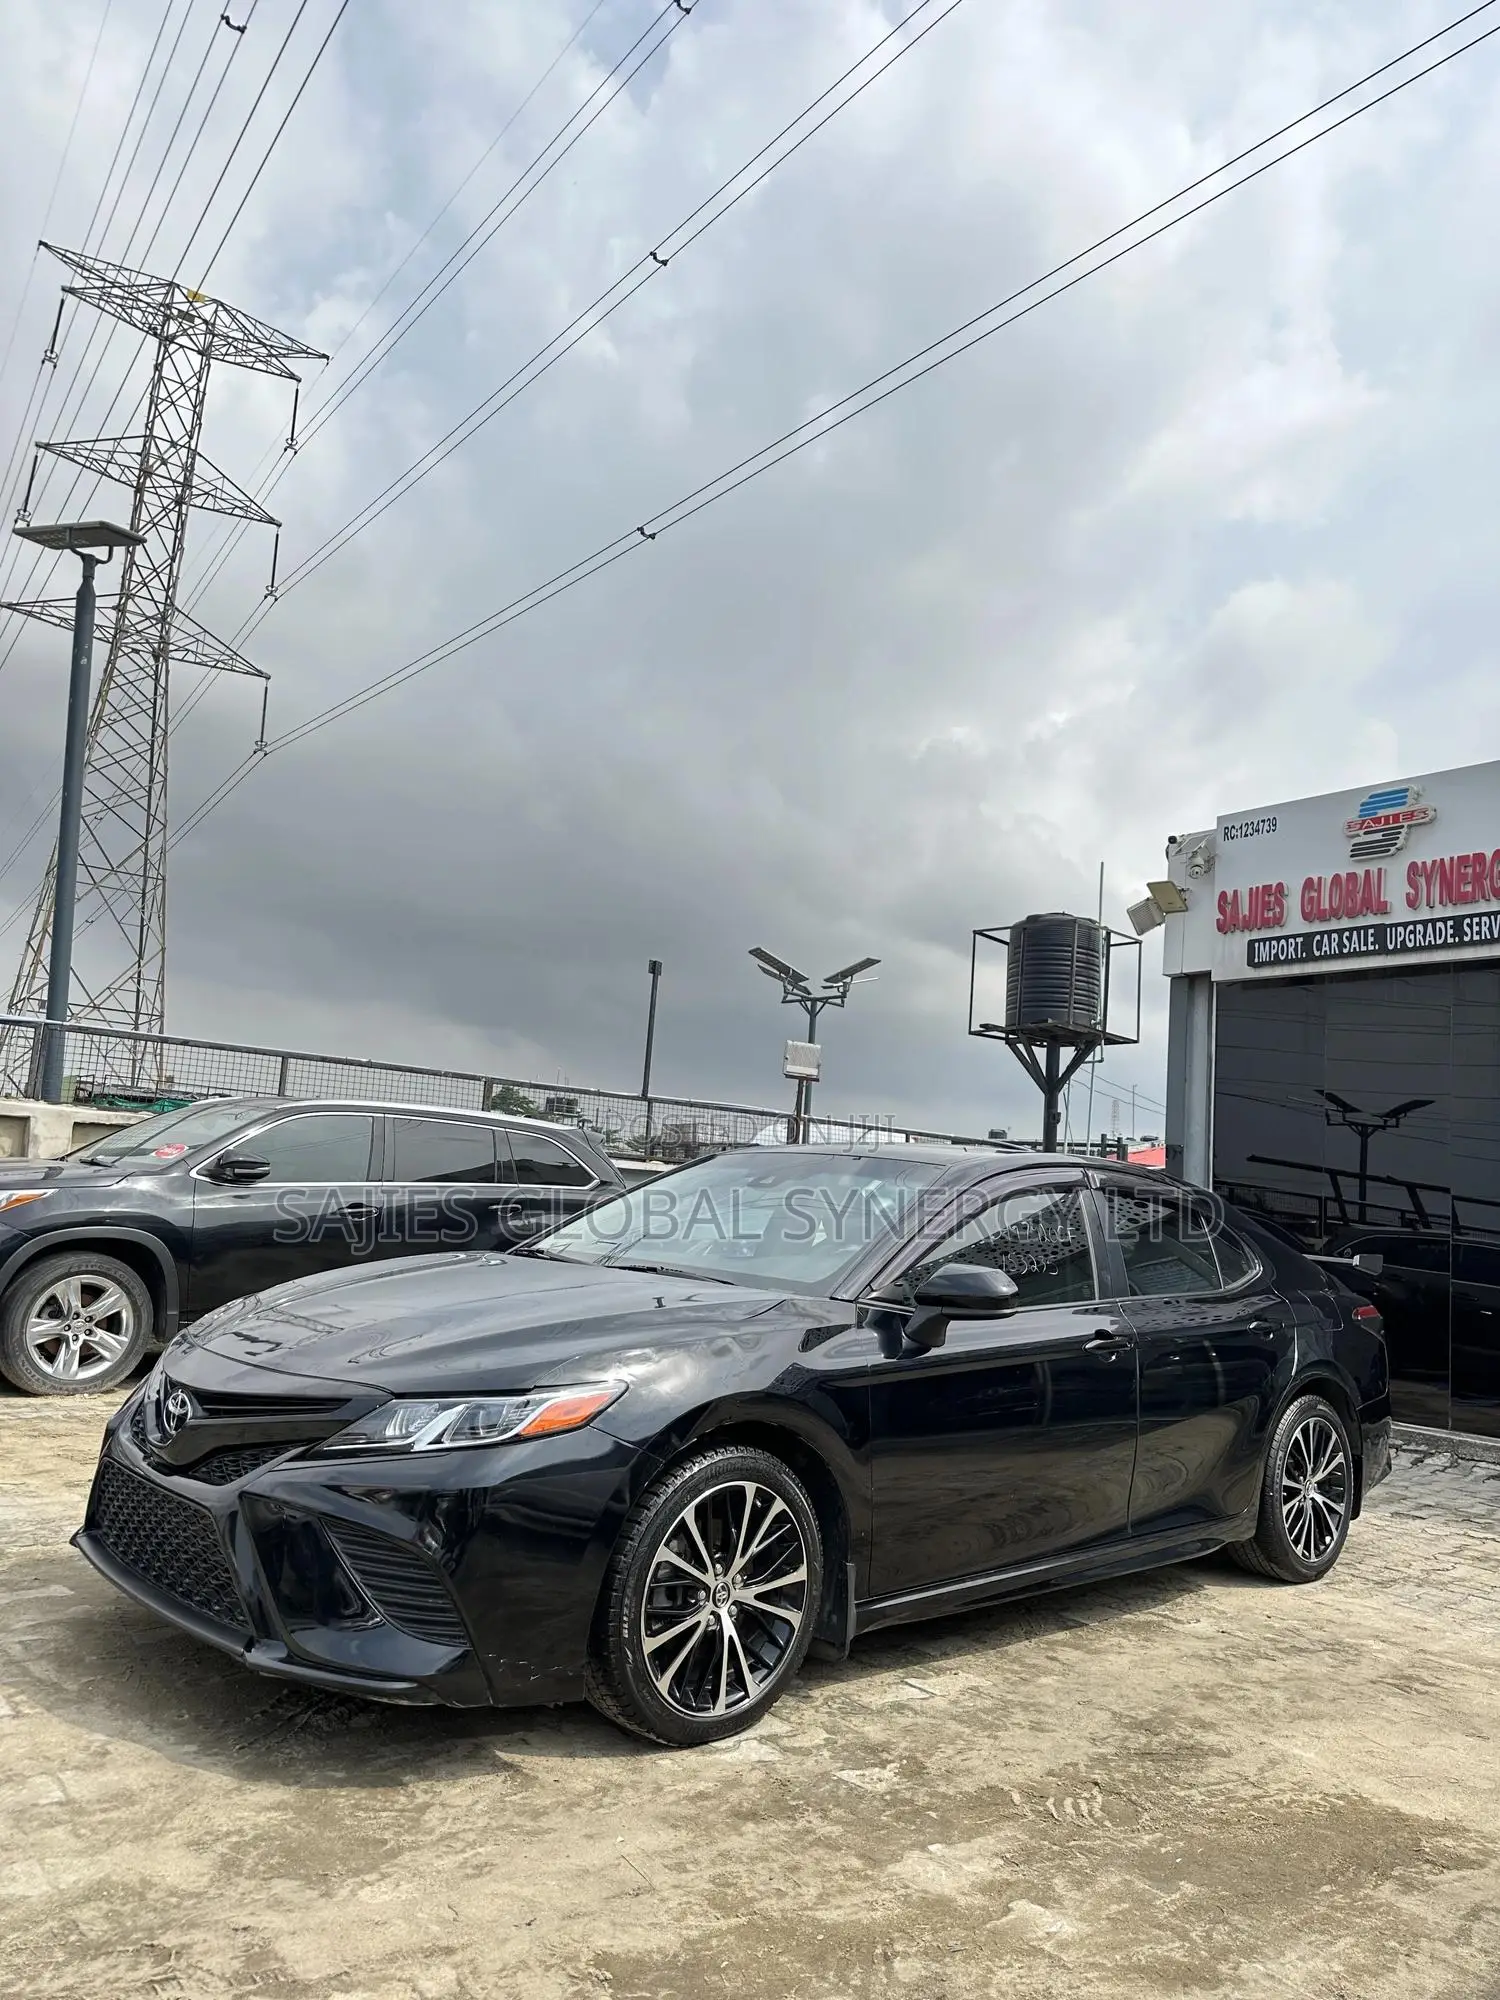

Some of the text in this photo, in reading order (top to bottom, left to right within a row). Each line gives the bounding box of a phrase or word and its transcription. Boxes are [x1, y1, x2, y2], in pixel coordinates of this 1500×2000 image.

[1223, 816, 1278, 842] RC:1234739
[1346, 807, 1430, 833] SAJIES
[1216, 881, 1287, 934] SAJIES
[1301, 867, 1390, 922] GLOBAL
[1254, 936, 1306, 963] IMPORT.
[1312, 932, 1339, 957] CAR
[1342, 927, 1379, 953] SALE.
[1386, 920, 1459, 950] UPGRADE.
